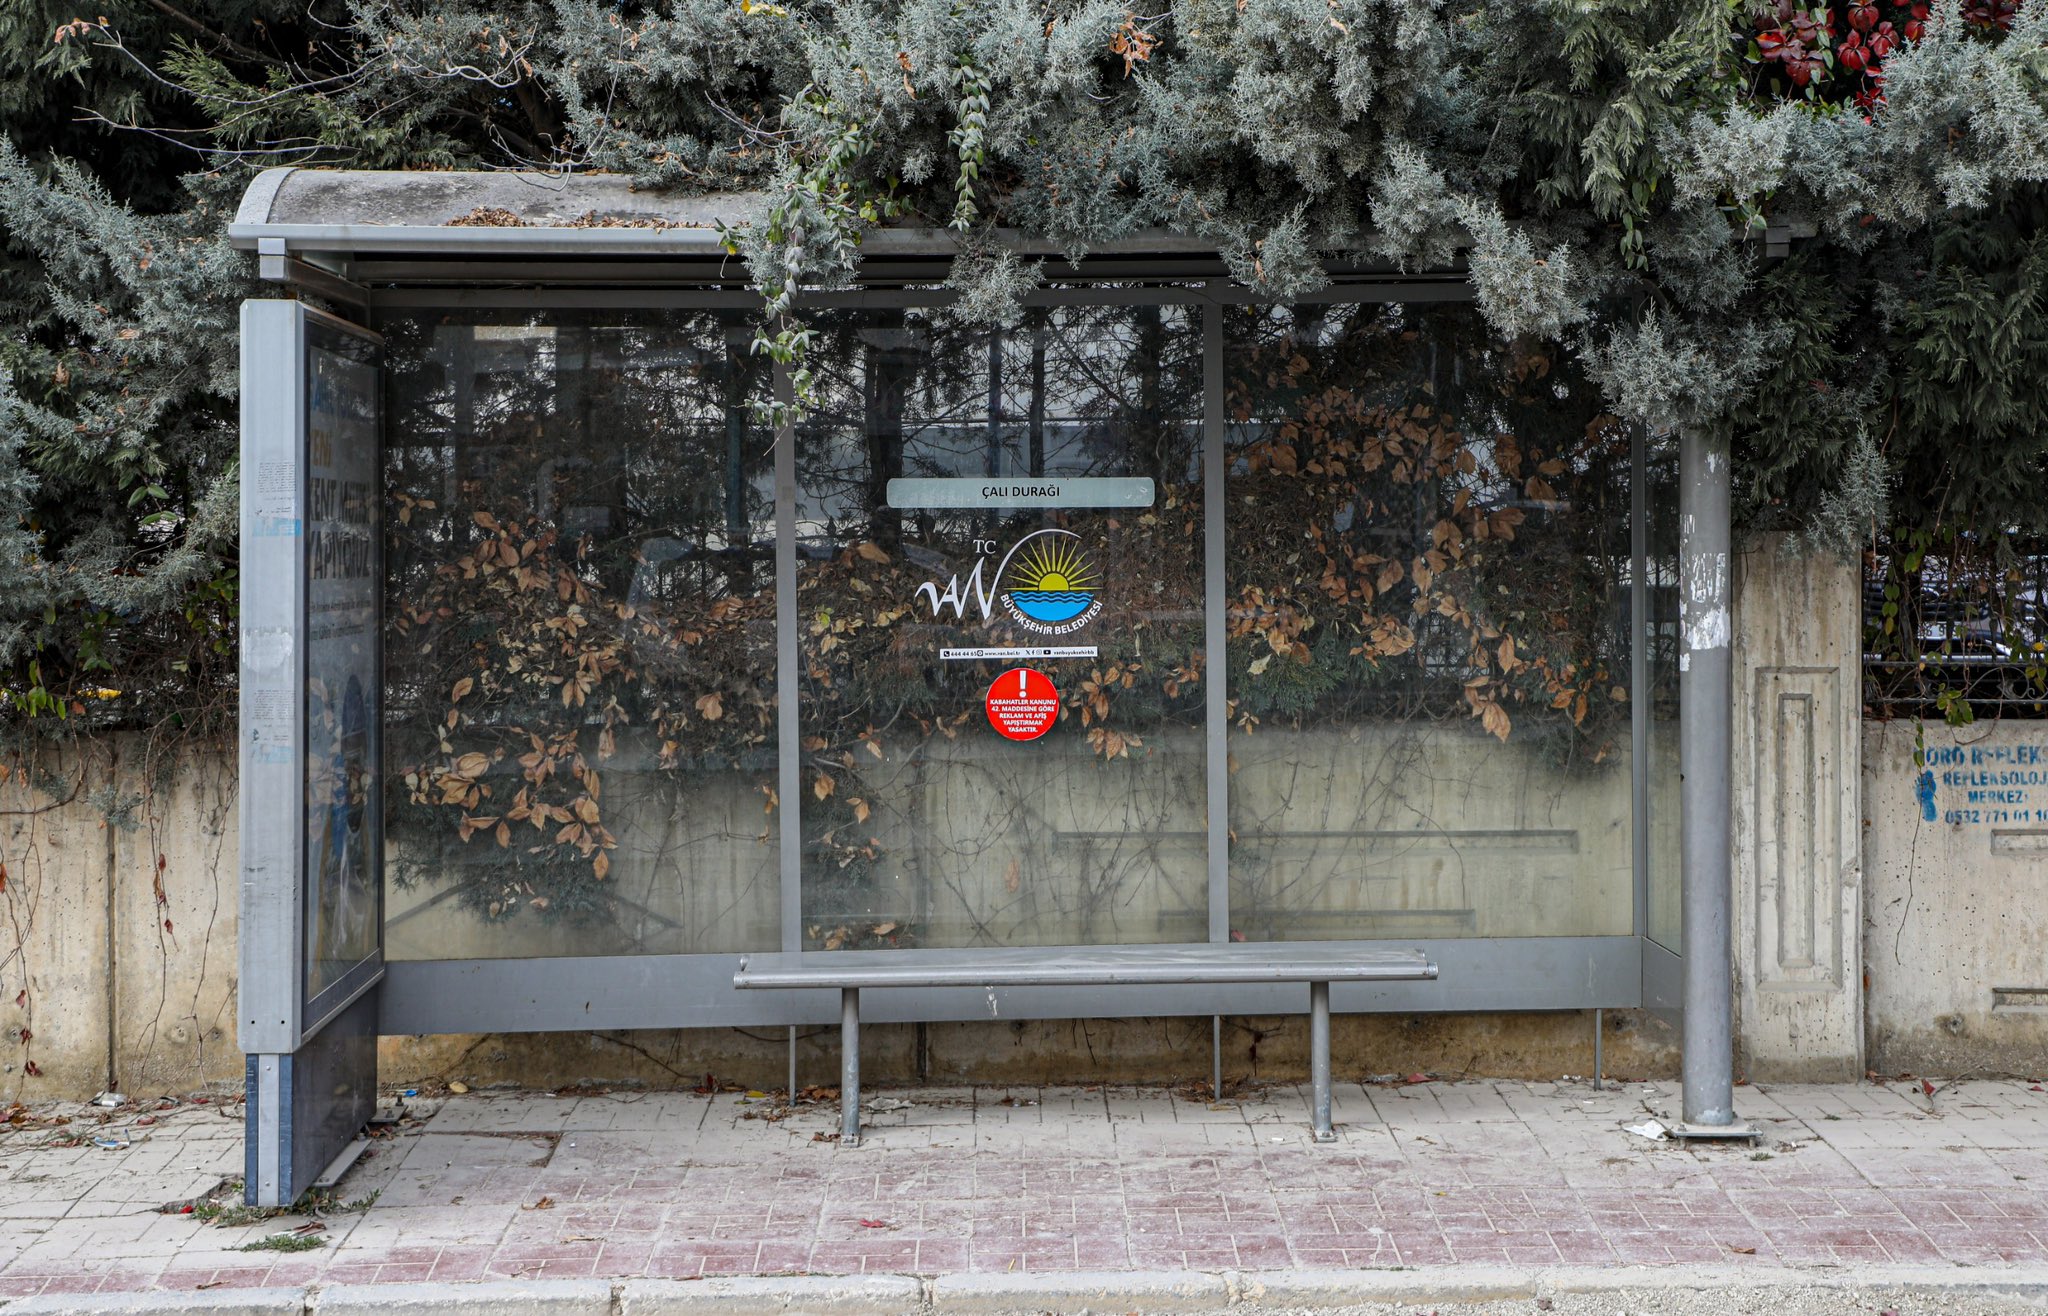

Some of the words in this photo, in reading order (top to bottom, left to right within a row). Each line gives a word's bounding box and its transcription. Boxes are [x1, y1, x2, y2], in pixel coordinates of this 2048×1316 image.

[982, 486, 1008, 500] ÇALI
[1012, 484, 1060, 497] DURAĞI
[973, 539, 996, 554] TC
[1000, 593, 1053, 635] BÜYÜKŞEHİR
[1054, 599, 1104, 635] BELEDİYESİ
[1033, 711, 1047, 720] AFİŞ
[1038, 704, 1055, 712] GÖRE
[1945, 809, 1980, 824] 0532
